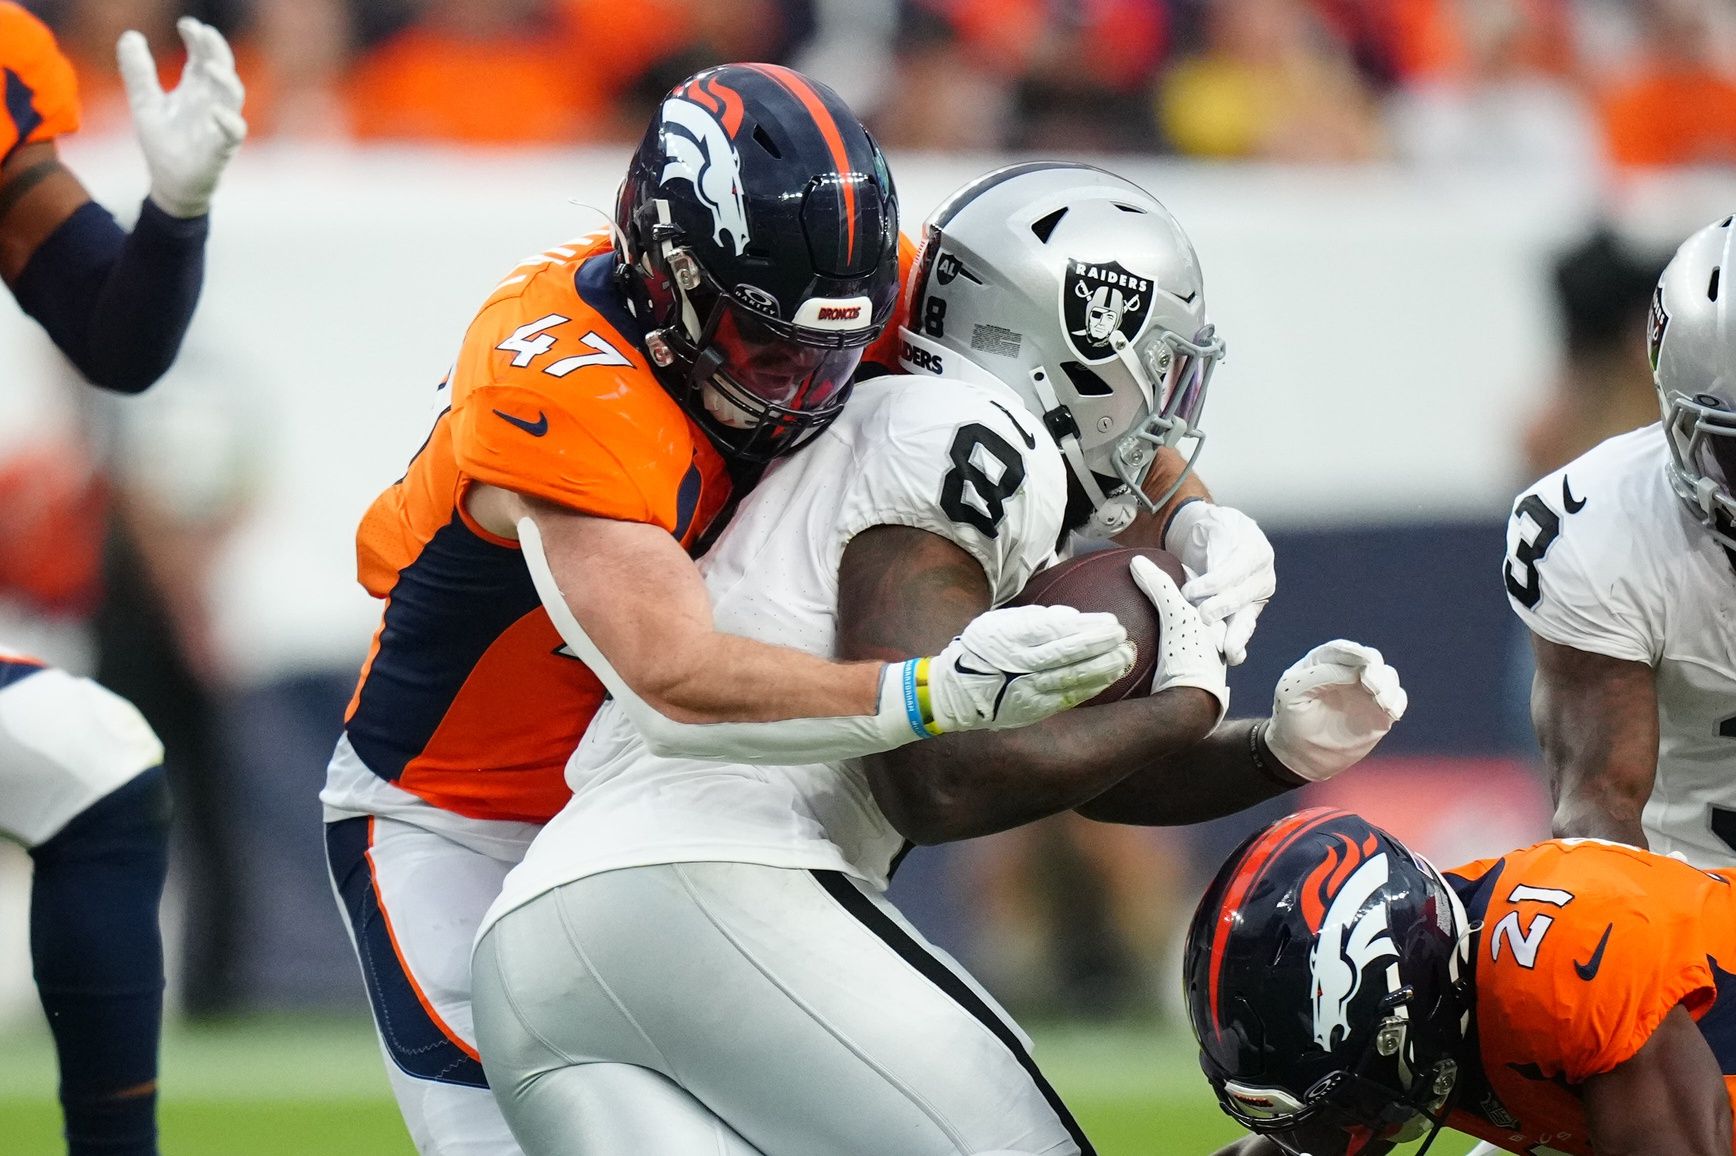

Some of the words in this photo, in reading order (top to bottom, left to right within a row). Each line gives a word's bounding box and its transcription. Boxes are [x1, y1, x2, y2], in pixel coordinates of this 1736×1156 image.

[938, 259, 955, 277] AL
[1075, 263, 1147, 292] RAIDERS
[818, 306, 861, 321] BRONCOS
[925, 296, 947, 338] 8
[495, 313, 638, 379] 47
[939, 421, 1026, 540] 8
[1504, 493, 1561, 610] 3
[1490, 883, 1576, 970] 21
